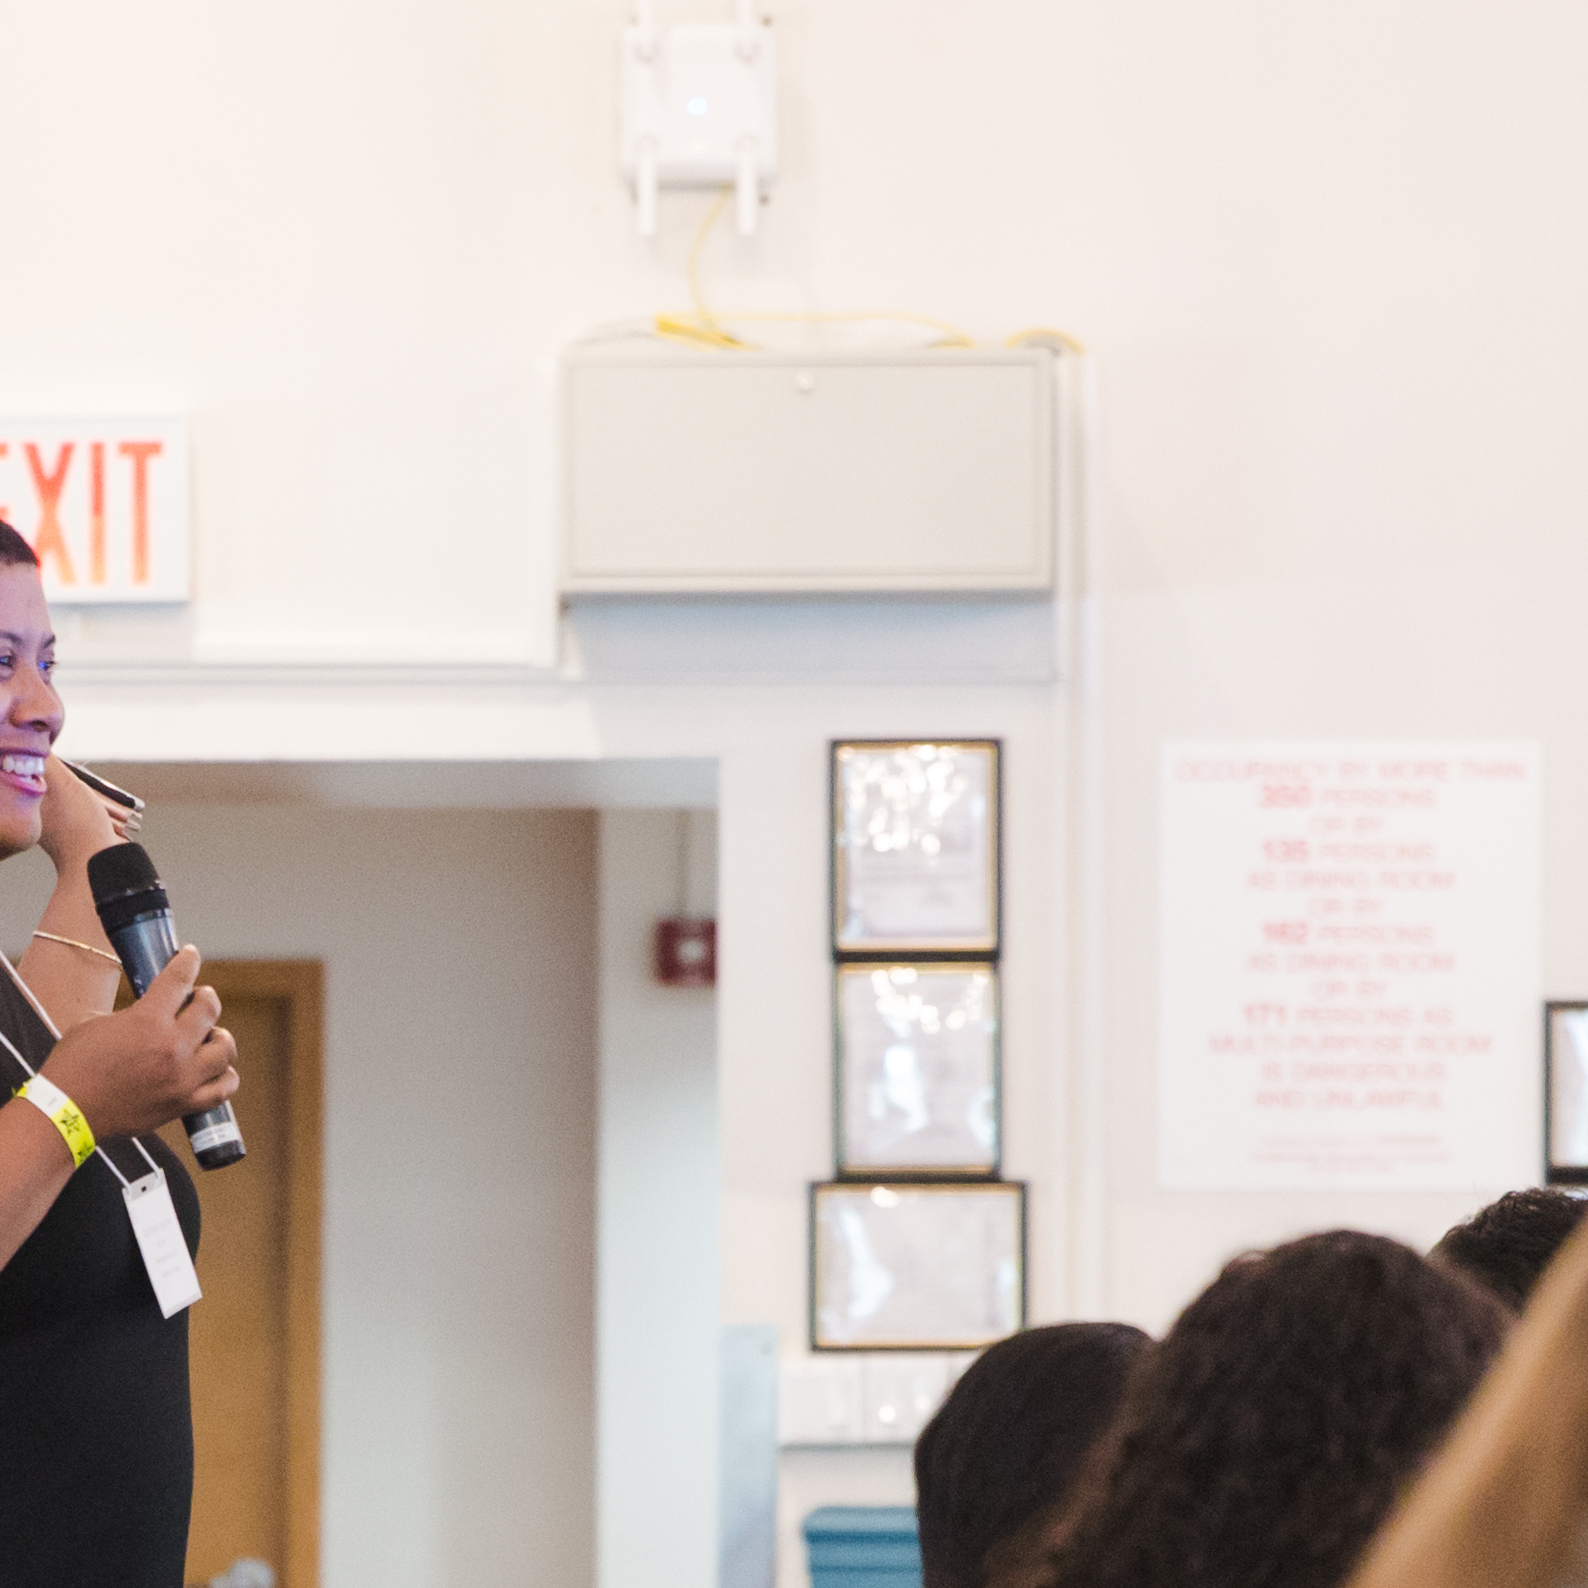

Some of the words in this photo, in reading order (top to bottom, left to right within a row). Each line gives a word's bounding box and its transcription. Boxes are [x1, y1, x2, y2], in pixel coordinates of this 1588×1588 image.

[1175, 759, 1327, 782] OCCUPANCY
[1340, 759, 1370, 782] BY
[1379, 759, 1451, 782] MORE
[1459, 759, 1526, 782] THAN
[1322, 786, 1437, 807] PERSONS
[1310, 813, 1344, 834] OR
[1354, 813, 1384, 834] BY
[1319, 841, 1435, 861] PERSONS
[1247, 868, 1278, 889] AS
[1287, 868, 1370, 889] DINING
[1379, 868, 1455, 889] ROOM
[1308, 895, 1344, 916] OR
[1354, 895, 1383, 916] BY
[1319, 922, 1434, 944] PERSONS
[1246, 951, 1279, 972] AS
[1286, 951, 1370, 972] DINING
[1379, 951, 1456, 972] ROOM
[1312, 977, 1349, 999] OR
[1358, 977, 1389, 999] BY
[1244, 1002, 1287, 1026] 171
[1297, 1005, 1414, 1026] PERSONS
[1423, 1005, 1454, 1026] AS
[1209, 1032, 1407, 1054] MULTI-PURPOSE
[1416, 1032, 1493, 1054] ROOM
[1262, 1060, 1283, 1081] IS
[1289, 1060, 1447, 1081] DANGEROUS
[1253, 1087, 1305, 1109] AND
[1311, 1087, 1442, 1109] UNLAWFUL
